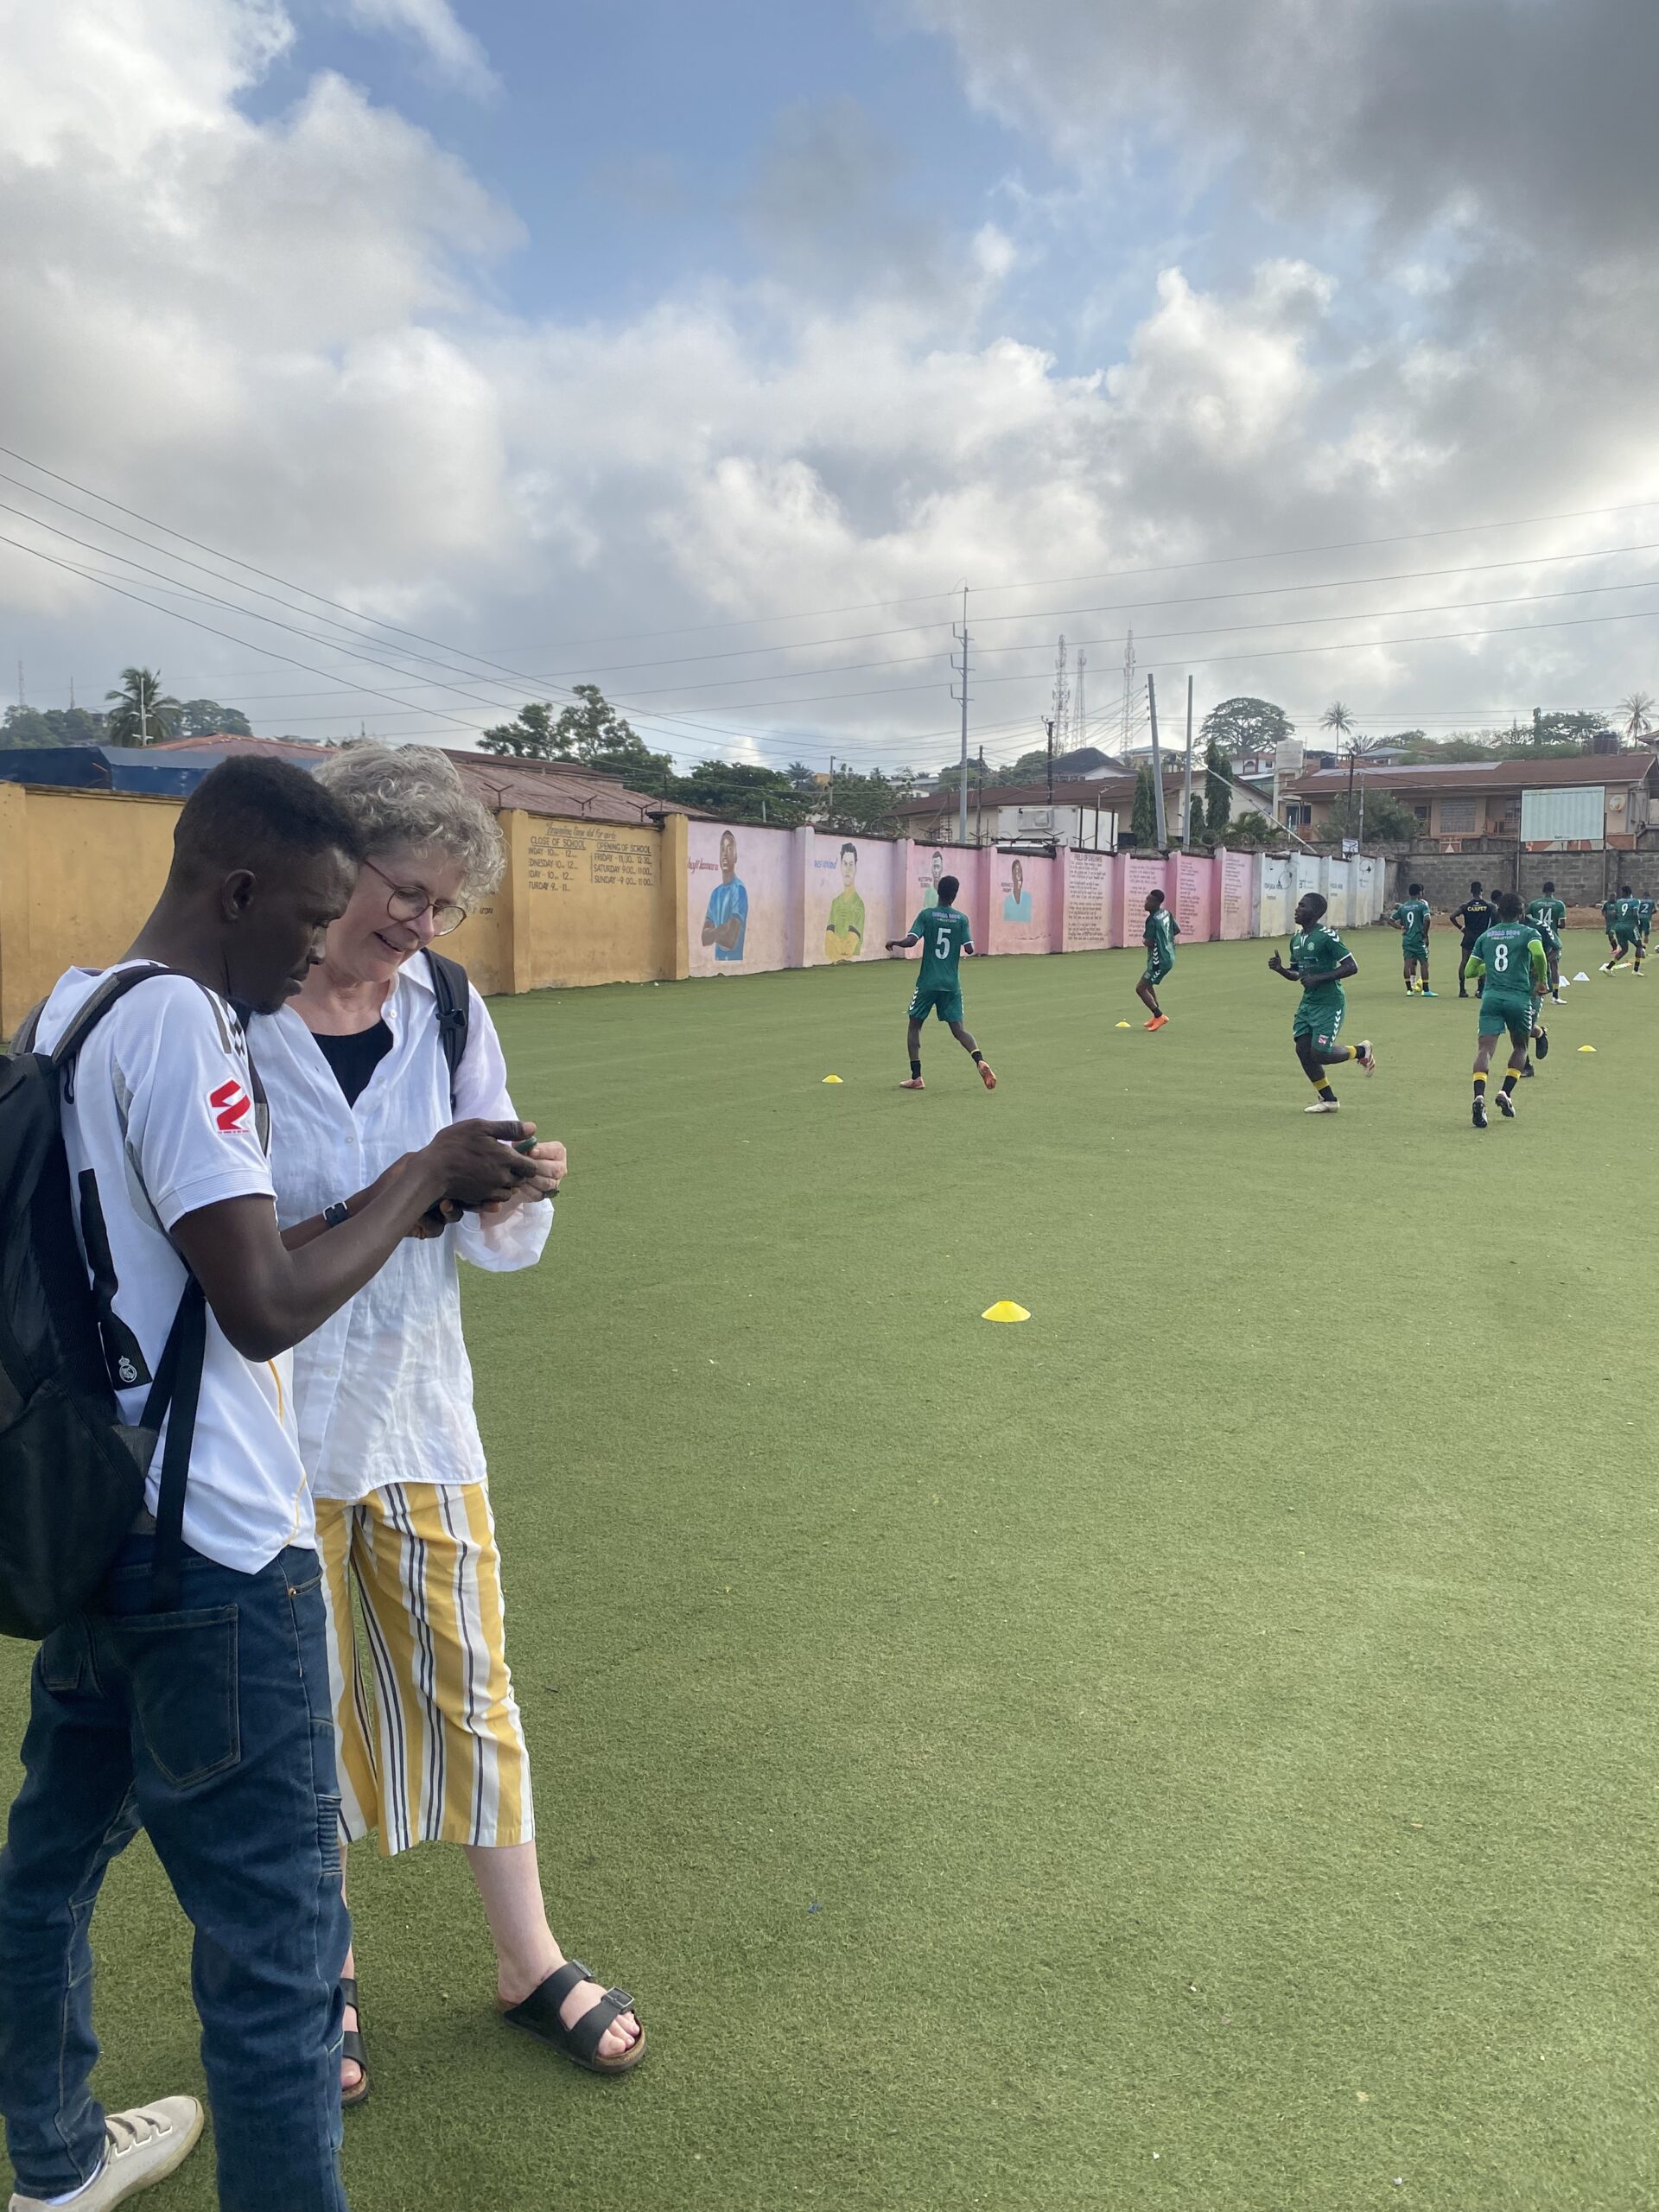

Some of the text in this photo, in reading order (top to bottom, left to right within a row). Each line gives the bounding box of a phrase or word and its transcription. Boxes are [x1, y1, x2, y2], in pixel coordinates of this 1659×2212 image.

[531, 836, 550, 845] CLOSE
[563, 839, 584, 849] SCHOOL
[597, 842, 620, 851] OPENING
[630, 844, 651, 854] SCHOOL
[594, 853, 613, 861] FRIDAY
[594, 864, 620, 873] SATURDAY
[594, 875, 616, 884] SUNDAY
[1621, 903, 1629, 916] 9
[1641, 904, 1649, 913] 2
[1407, 912, 1414, 928] 9
[1538, 908, 1553, 924] 14
[935, 927, 951, 960] 5
[1494, 944, 1509, 972] 8
